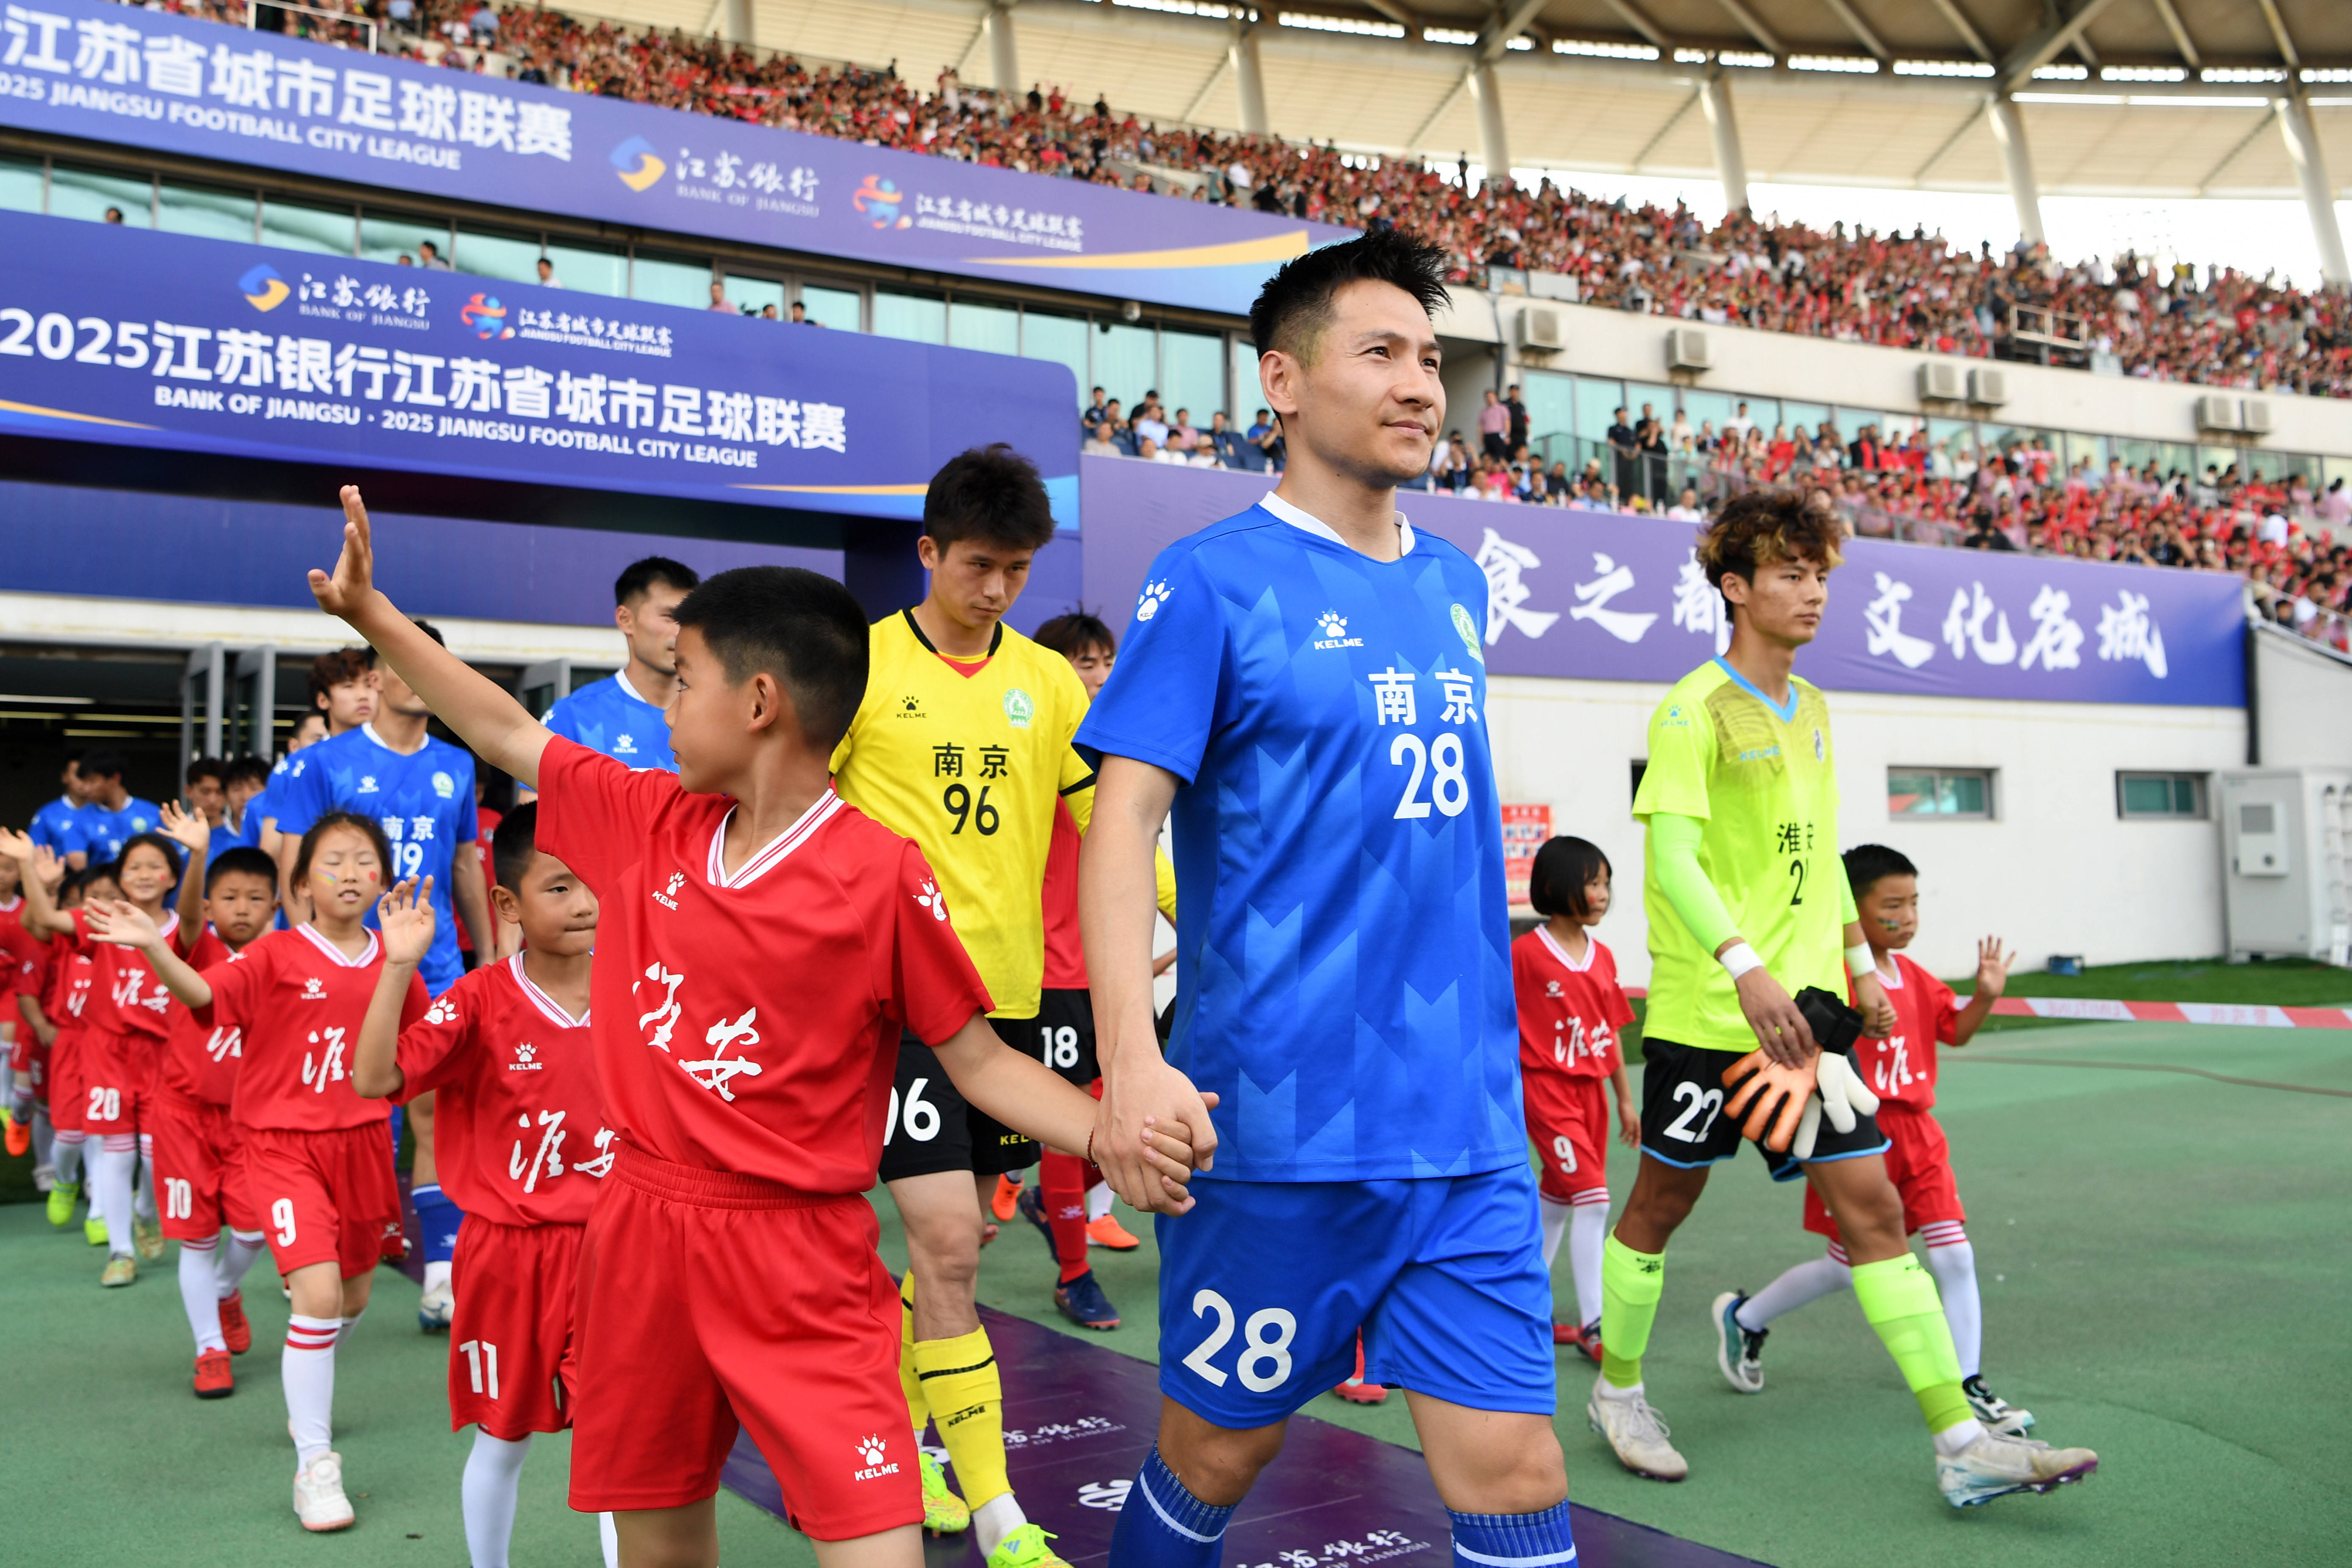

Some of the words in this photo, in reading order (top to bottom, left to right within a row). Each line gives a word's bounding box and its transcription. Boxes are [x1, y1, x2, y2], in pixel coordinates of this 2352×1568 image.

[0, 3, 572, 162] 江苏省城市足球联赛
[49, 81, 164, 120] JIANGSU
[169, 101, 303, 144] FOOTBALL
[307, 126, 363, 153] CITY
[368, 135, 461, 170] LEAGUE
[676, 147, 819, 202] 江苏银行
[676, 185, 721, 203] BANK
[727, 193, 750, 206] OF
[756, 197, 819, 218] JIANGSU
[299, 272, 431, 317] 江苏银行
[299, 303, 340, 320] BANK
[346, 310, 366, 322] OF
[372, 313, 430, 331] JIANGSU
[519, 308, 673, 347] 江苏省城市足球联赛
[519, 327, 563, 343] JIANGSU
[563, 334, 611, 350] FOOTBALL
[614, 340, 634, 352] CITY
[0, 308, 846, 453] 2025江苏银行江苏省城市足球联赛
[155, 386, 223, 411] BANK
[228, 393, 262, 415] OF
[265, 397, 361, 425] JIANGSU
[382, 410, 433, 433] 2025
[437, 416, 525, 443] JIANGSU
[530, 426, 634, 455] FOOTBALL
[637, 438, 680, 459] CITY
[683, 443, 757, 468] LEAGUE
[1314, 638, 1364, 650] KELME
[1863, 571, 2167, 678] 文化名城
[1368, 667, 1478, 725] 南京
[932, 742, 1010, 779] 南京
[1740, 746, 1780, 761] KELME
[1390, 732, 1469, 819] 28
[381, 815, 435, 841] 南京
[944, 784, 999, 836] 96
[392, 842, 423, 877] 19
[652, 890, 679, 911] KELME
[1790, 858, 1809, 906] 2
[302, 1026, 354, 1094] 淮
[509, 1063, 543, 1071] KELME
[1041, 1026, 1078, 1068] 18
[1875, 1036, 1926, 1096] 淮
[87, 1086, 120, 1121] 20
[1663, 1081, 1724, 1143] 22
[1000, 1134, 1031, 1146] KEL
[1553, 1135, 1578, 1174] 9
[164, 1177, 192, 1220] 10
[271, 1198, 296, 1247] 9
[1182, 1289, 1297, 1393] 28
[459, 1339, 499, 1400] 11
[948, 1406, 986, 1427] KELME
[1003, 1416, 1111, 1443] 苏银行
[854, 1462, 899, 1481] KELME
[1237, 1529, 1411, 1568] 苏银行
